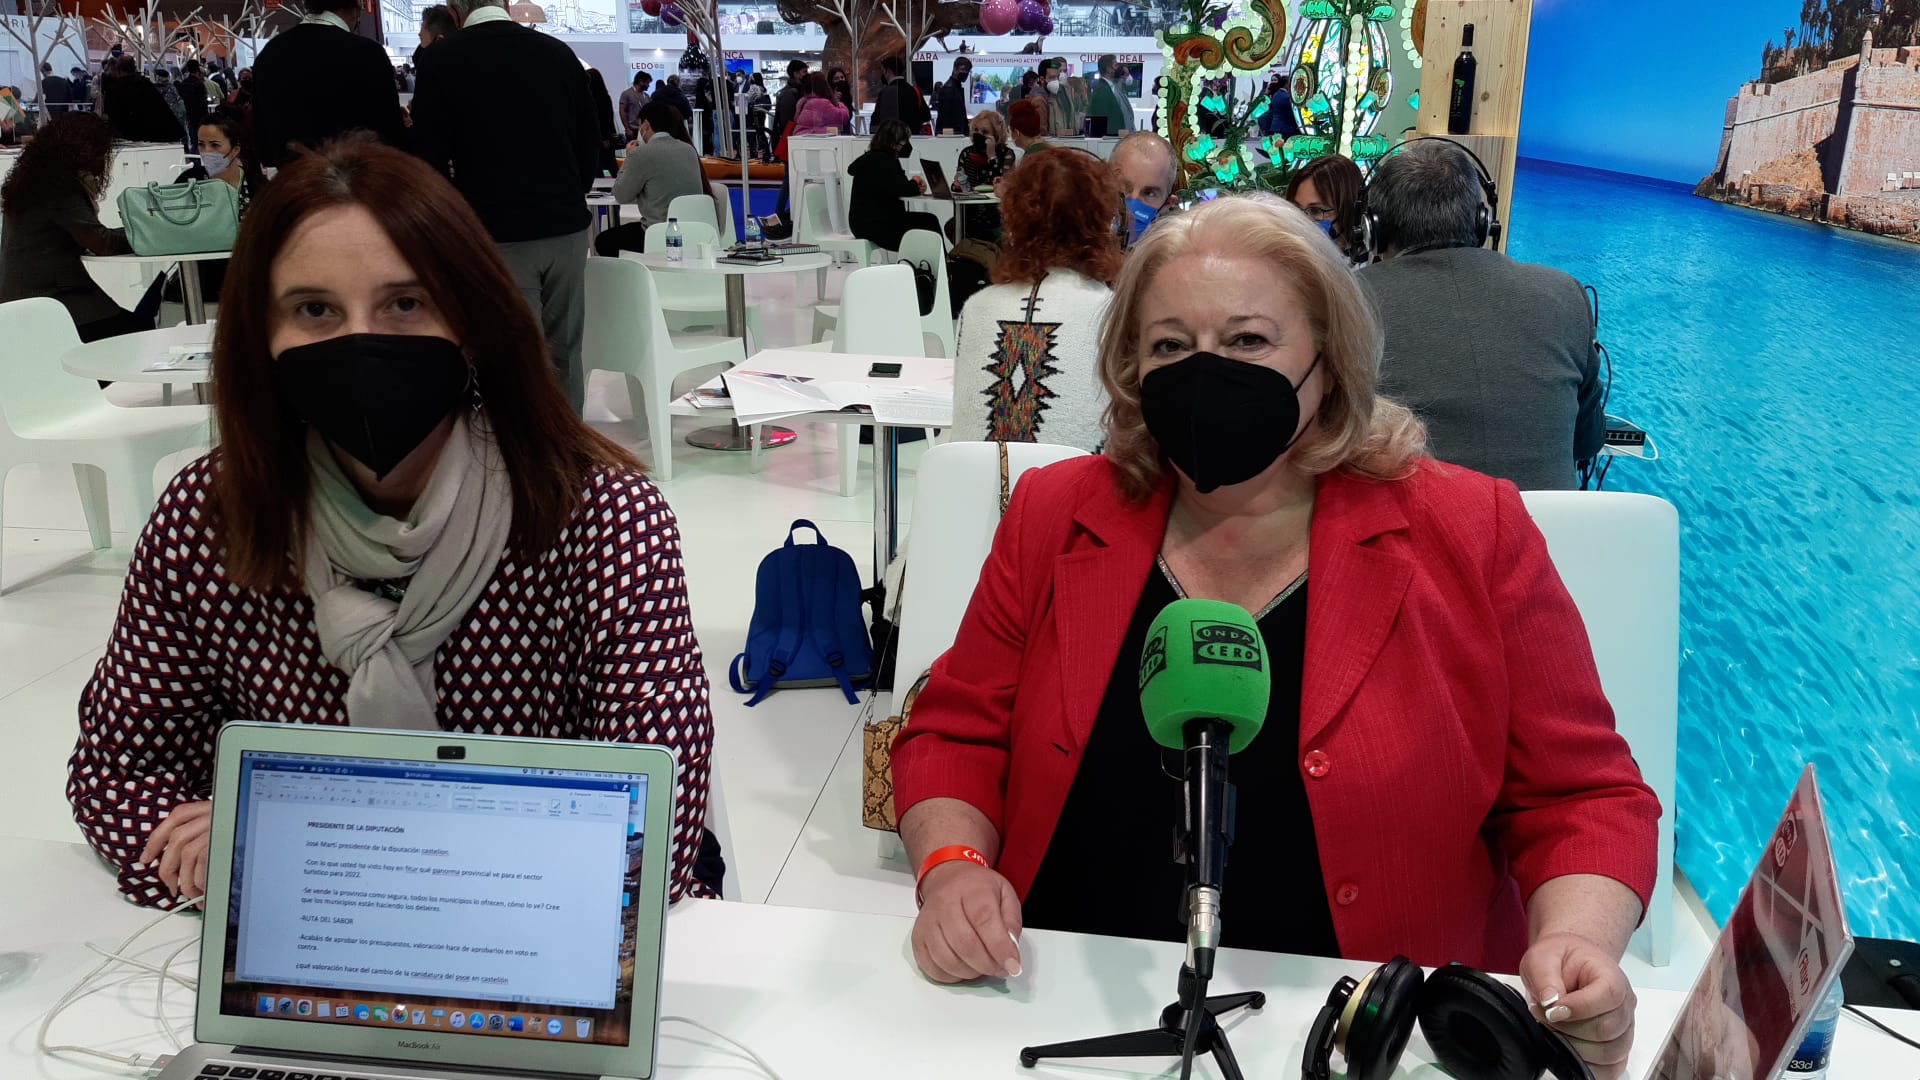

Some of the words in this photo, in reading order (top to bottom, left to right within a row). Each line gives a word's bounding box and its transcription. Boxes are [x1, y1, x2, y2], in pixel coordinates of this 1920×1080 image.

[1202, 628, 1251, 642] ONDA
[1206, 645, 1253, 660] CERO
[308, 822, 344, 830] PRESIDENTE
[365, 825, 405, 833] DIPUTACIÓN
[462, 869, 491, 878] provincial
[398, 1040, 429, 1049] MacBook
[1790, 1059, 1813, 1070] 33cl
